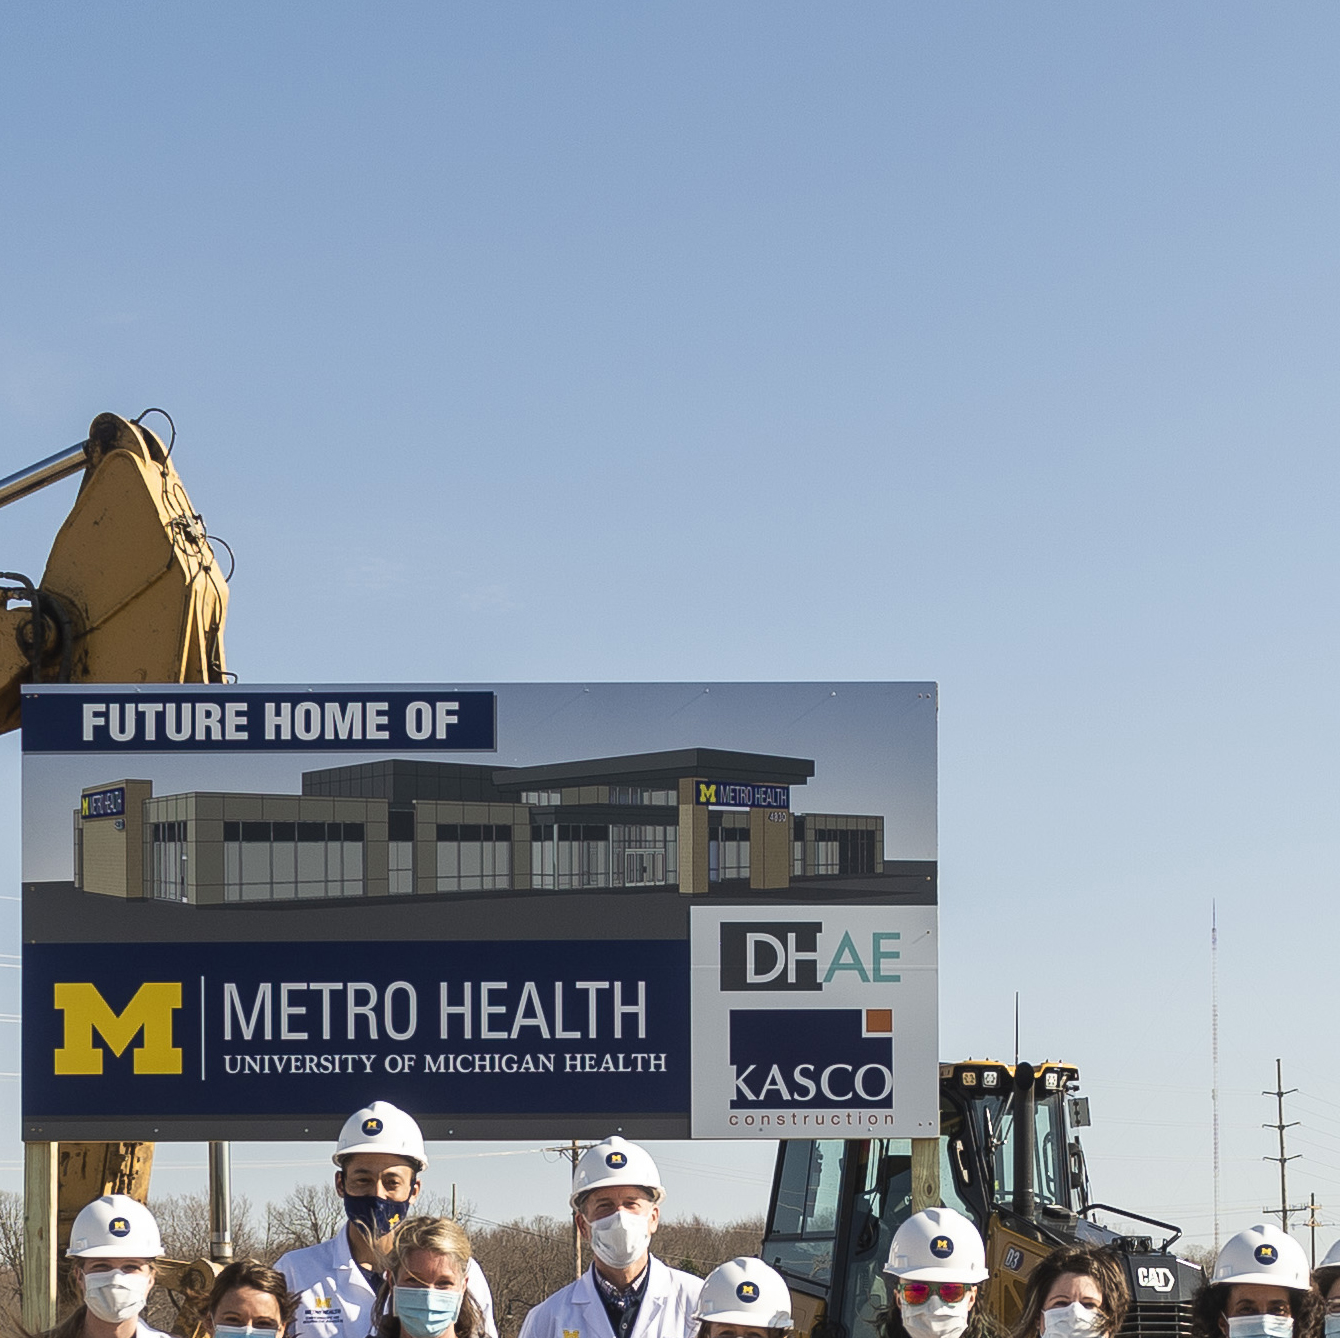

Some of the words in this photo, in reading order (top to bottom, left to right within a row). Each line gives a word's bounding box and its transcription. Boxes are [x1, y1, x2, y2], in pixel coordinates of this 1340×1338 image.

[82, 702, 249, 742] FUTURE
[264, 701, 390, 741] HOME
[405, 701, 459, 740] OF
[700, 784, 716, 803] M
[720, 785, 752, 804] METRO
[755, 787, 787, 806] HEALTH
[746, 929, 901, 983] DHAE
[224, 981, 417, 1040] METRO
[440, 981, 646, 1039] HEALTH
[54, 982, 182, 1075] M
[223, 1054, 377, 1074] UNIVERSITY
[384, 1054, 416, 1073] OF
[424, 1053, 555, 1073] MICHIGAN
[564, 1053, 668, 1072] HEALTH
[729, 1063, 894, 1101] KASCO
[729, 1112, 894, 1126] construction
[1005, 1248, 1020, 1269] D3
[1137, 1267, 1175, 1292] CAT
